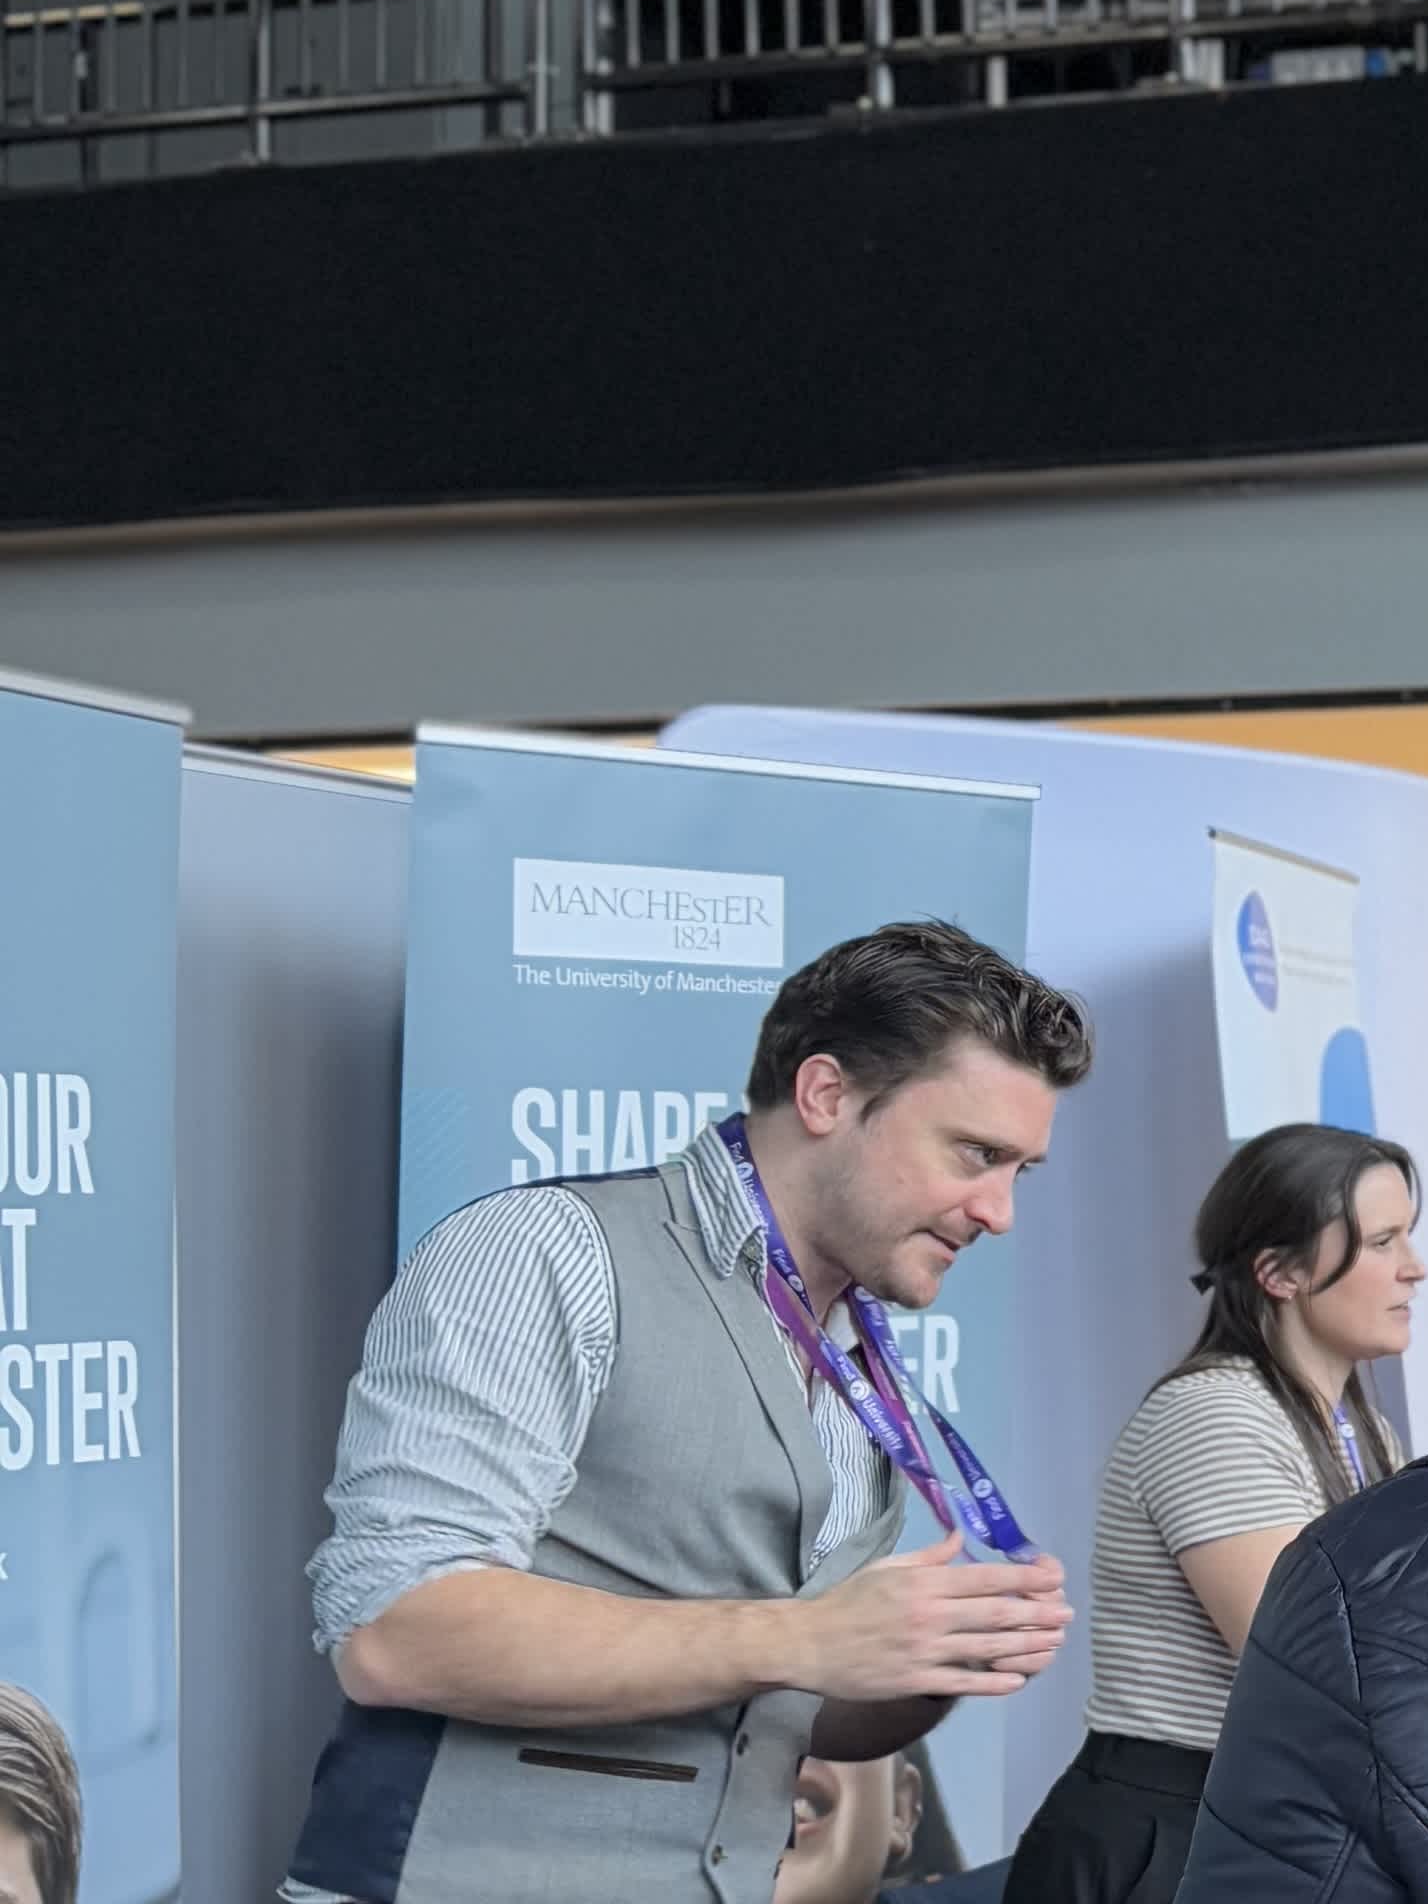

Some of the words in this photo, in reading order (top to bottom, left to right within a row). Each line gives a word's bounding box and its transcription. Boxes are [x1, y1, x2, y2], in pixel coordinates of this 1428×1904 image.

[531, 882, 773, 927] MANCHESTER
[672, 924, 721, 952] 1824
[512, 963, 550, 986] The
[555, 966, 650, 995] University
[655, 970, 675, 991] of
[677, 972, 783, 995] Manchester
[0, 1071, 95, 1197] UR
[836, 1355, 856, 1383] Find
[862, 1398, 904, 1451] University
